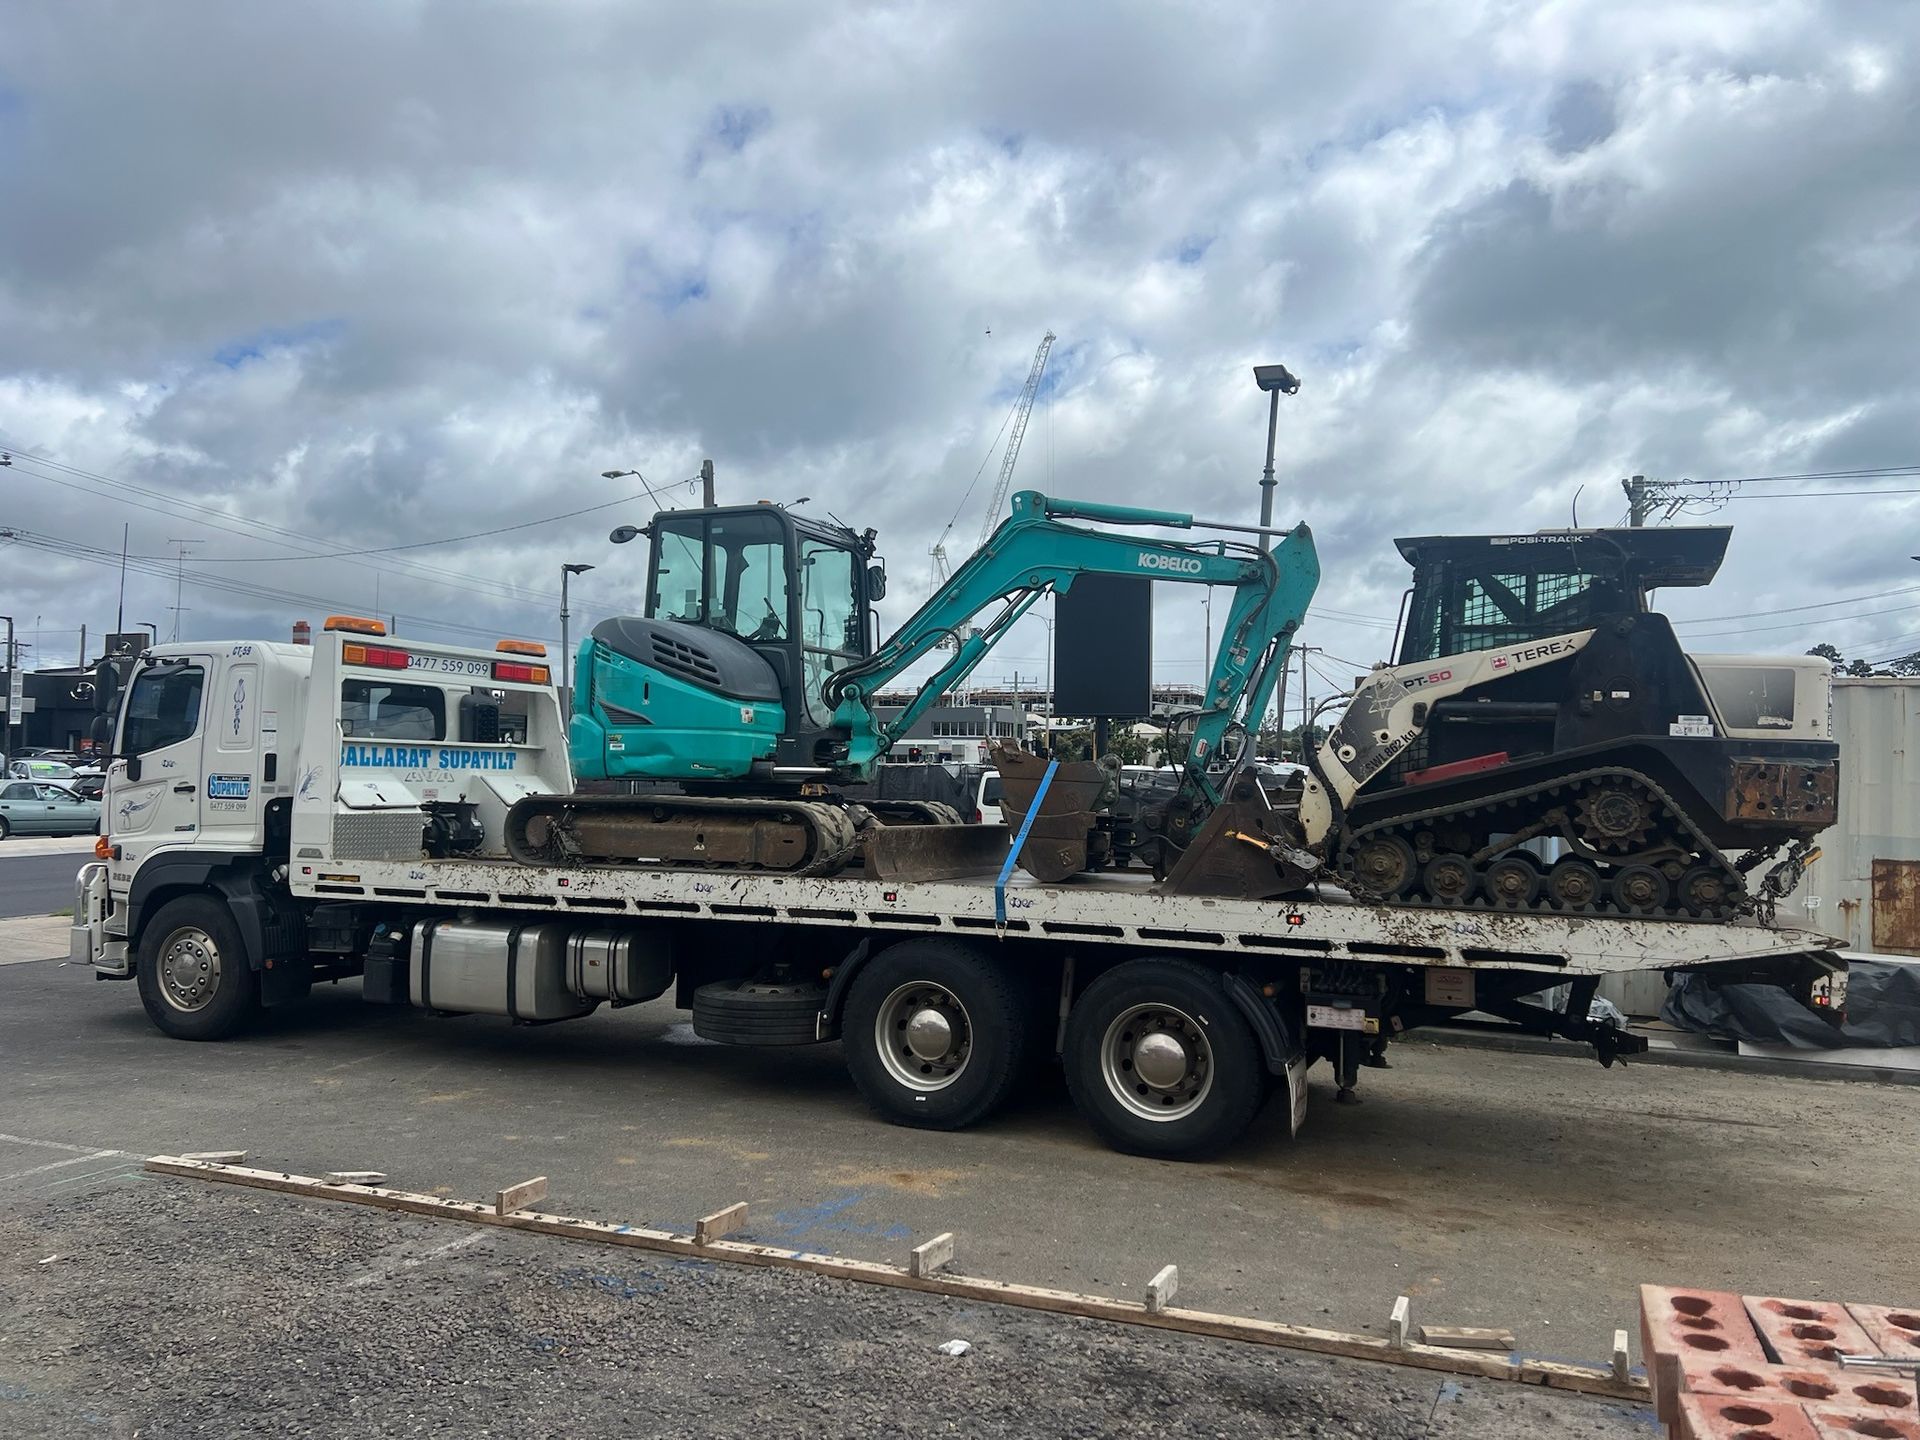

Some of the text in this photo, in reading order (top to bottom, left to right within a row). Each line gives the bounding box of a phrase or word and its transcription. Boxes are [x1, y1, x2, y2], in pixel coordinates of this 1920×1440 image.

[1510, 535, 1583, 544] POSI-TRACK
[1138, 552, 1202, 574] KOBELCO
[1511, 639, 1575, 663] TEREX
[408, 655, 488, 675] 0477 559 099
[1403, 670, 1452, 688] PT-50
[439, 750, 516, 769] SUPATILT
[1365, 728, 1417, 773] SWL 862 kg
[210, 774, 250, 797] SUPATILT
